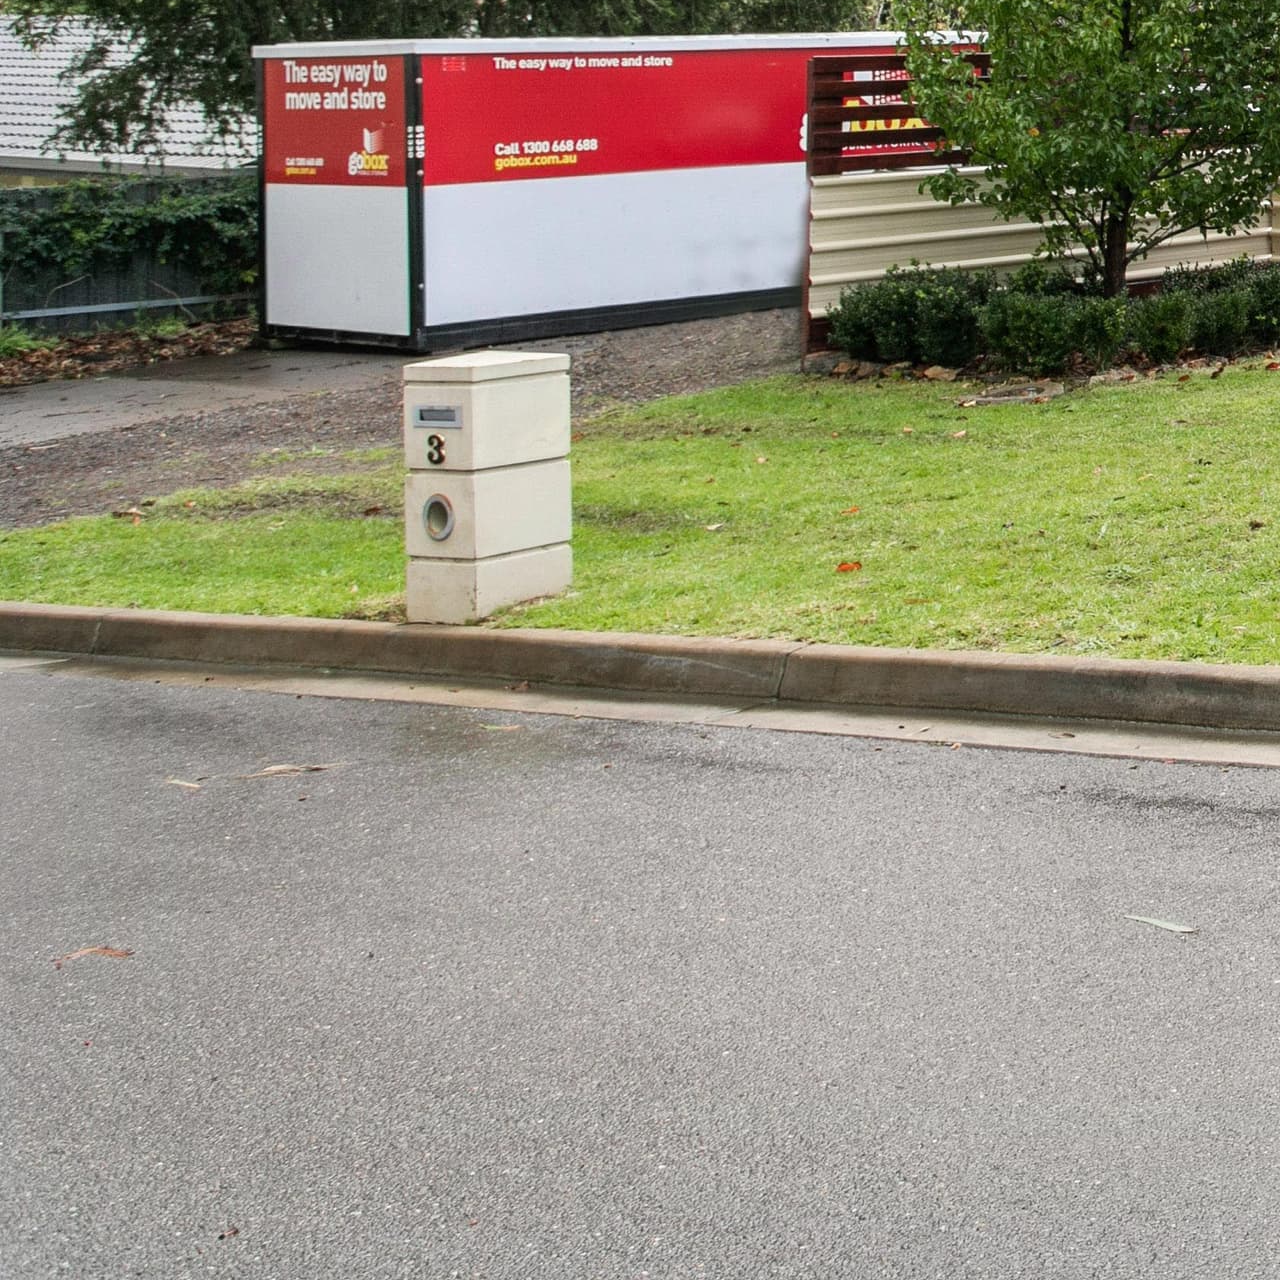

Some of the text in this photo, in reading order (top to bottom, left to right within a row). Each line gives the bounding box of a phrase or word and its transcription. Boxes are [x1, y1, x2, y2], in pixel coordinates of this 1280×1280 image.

[493, 55, 673, 71] The easy way to move and store
[283, 60, 388, 88] The easy way to
[285, 87, 387, 110] move and store
[494, 138, 599, 156] Call 1300 668 688
[495, 154, 577, 171] gobox.com.au
[427, 433, 447, 465] 3
